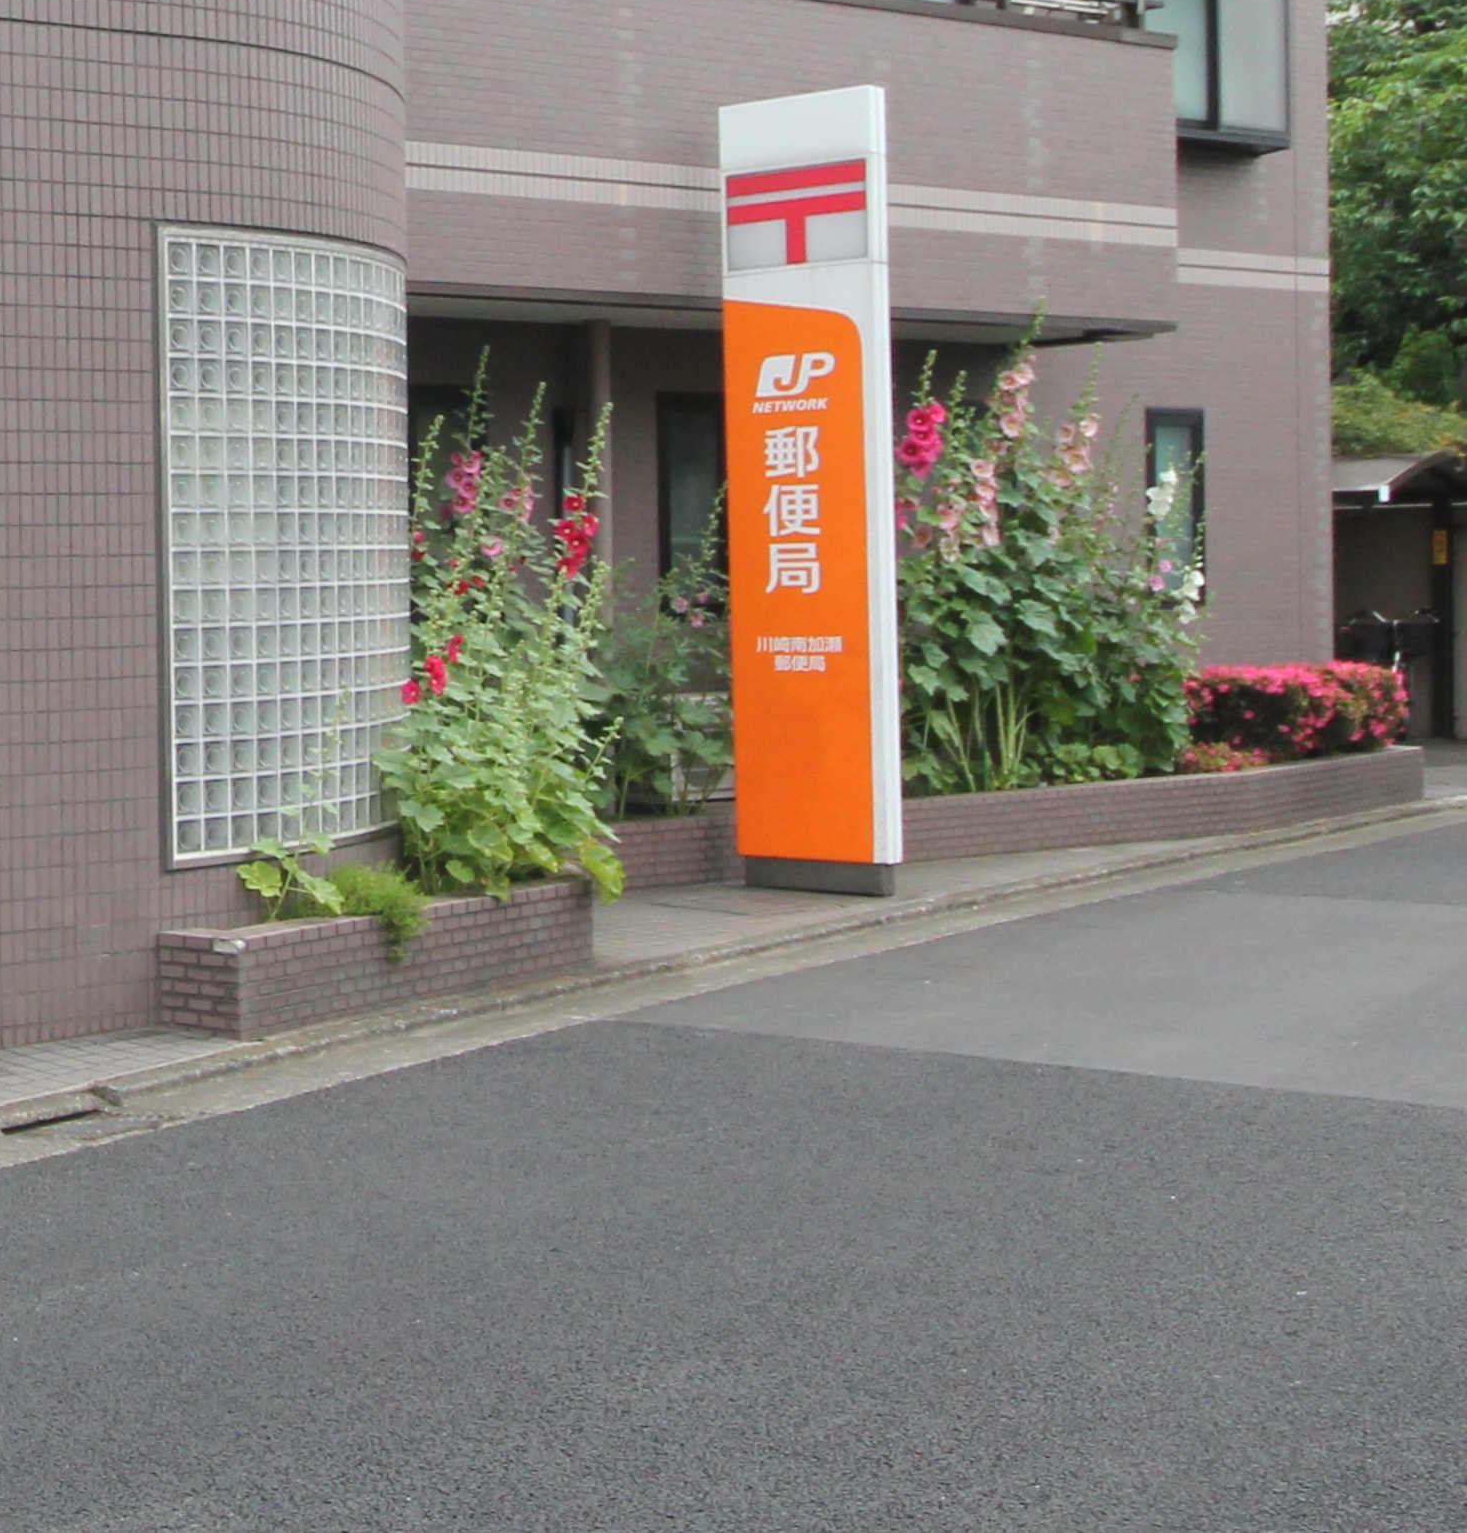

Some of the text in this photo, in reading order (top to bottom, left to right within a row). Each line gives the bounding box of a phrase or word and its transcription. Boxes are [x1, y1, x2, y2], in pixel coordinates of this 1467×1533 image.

[752, 397, 829, 414] NETWORK
[763, 425, 822, 594] 郵便局
[756, 635, 843, 653] 川崎南加瀬
[774, 654, 826, 672] 郵便局
